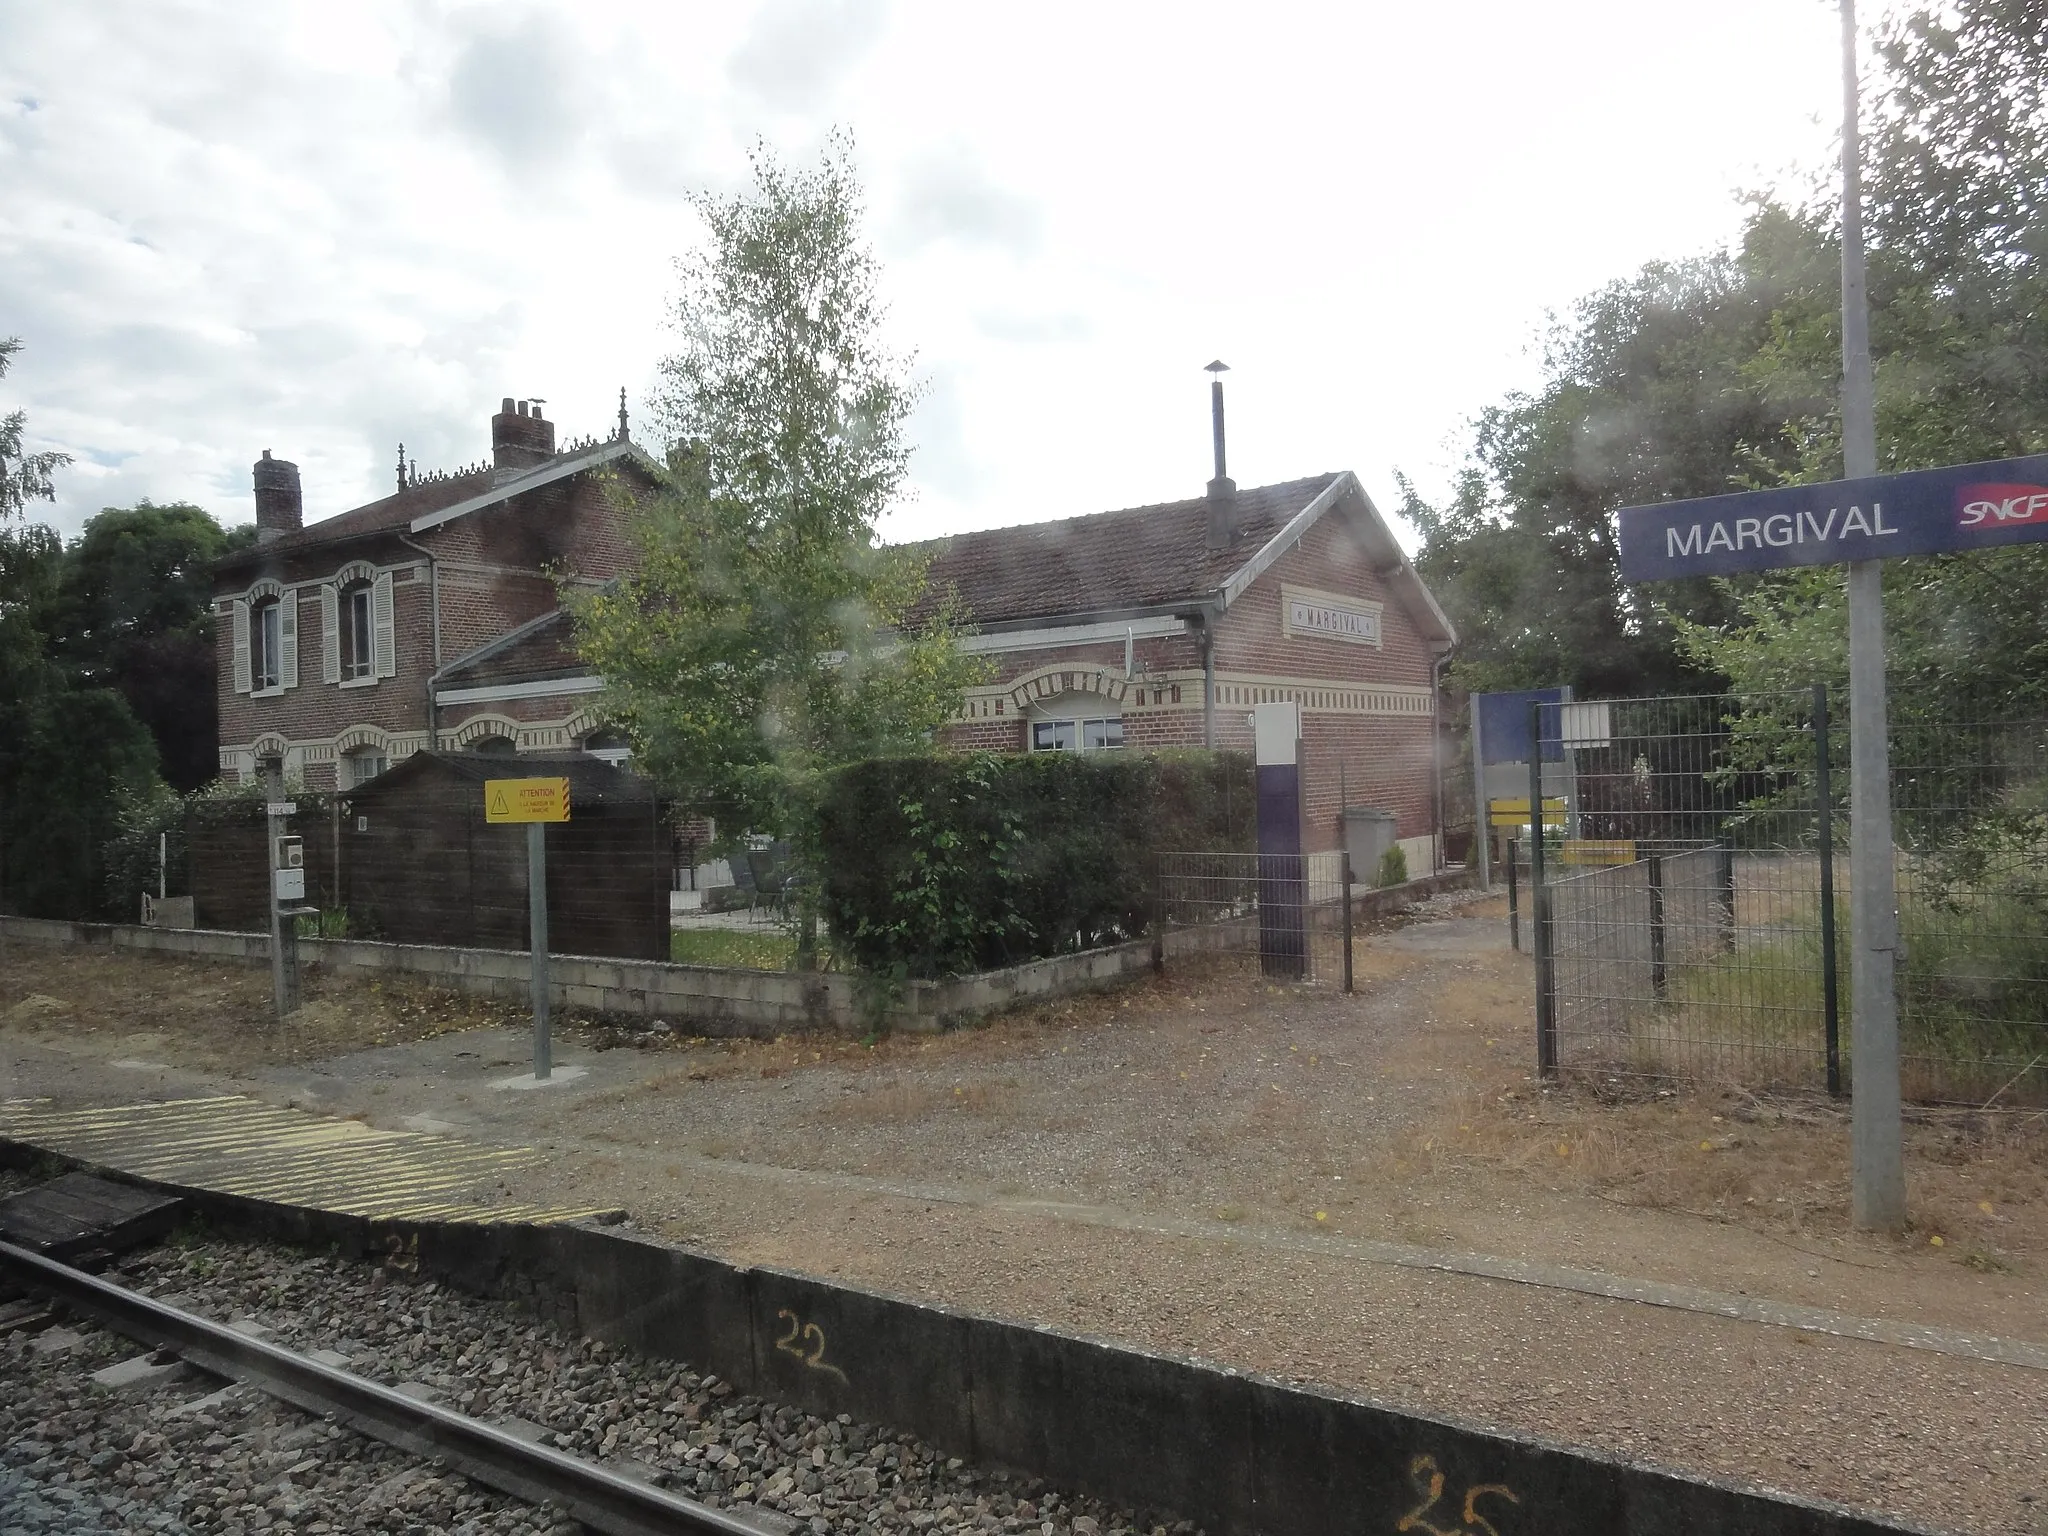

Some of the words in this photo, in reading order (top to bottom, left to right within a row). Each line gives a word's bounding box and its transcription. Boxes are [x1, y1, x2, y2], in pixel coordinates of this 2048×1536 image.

[1959, 493, 2048, 526] SNCF
[1666, 503, 1899, 558] MARGIVAL
[1307, 607, 1362, 634] MARGIVAL
[519, 788, 555, 798] ATTENTION
[776, 1309, 851, 1388] 22
